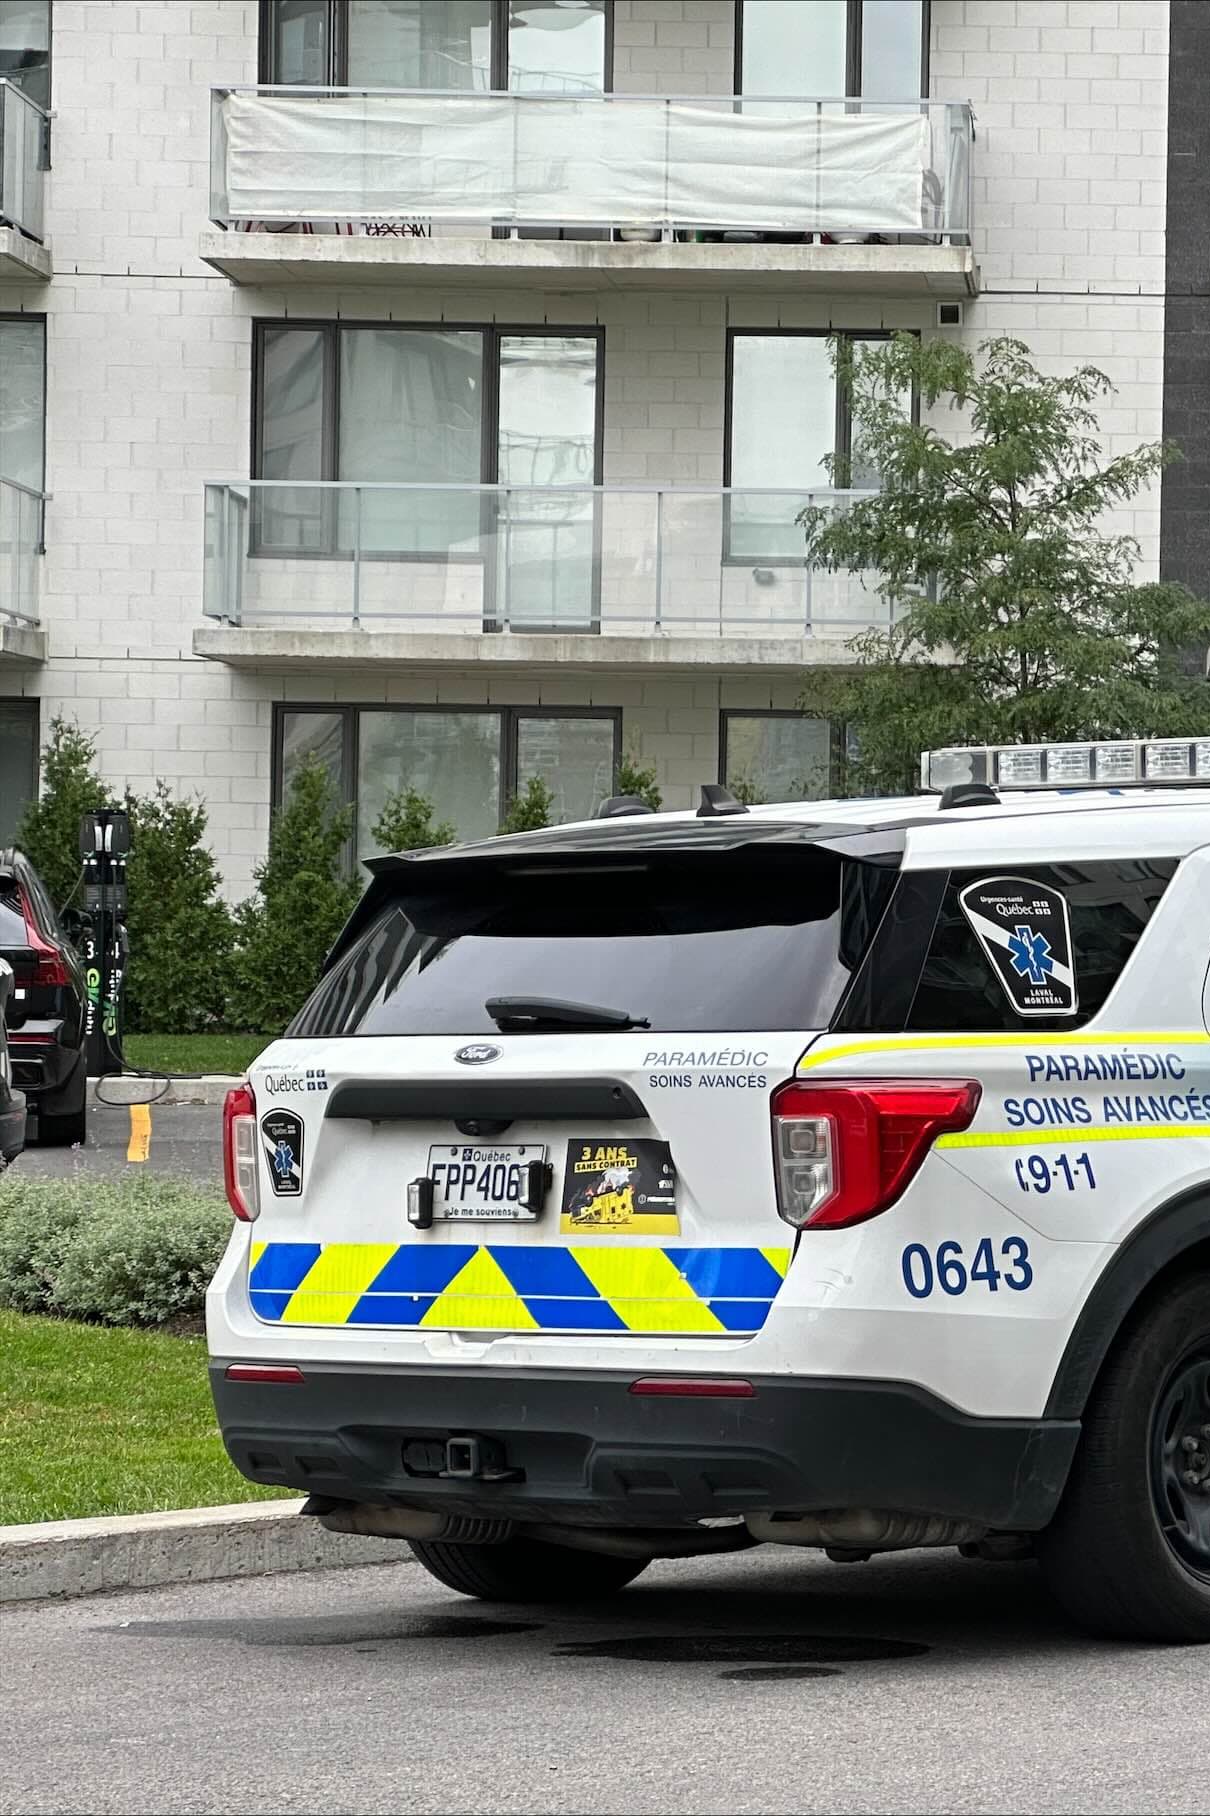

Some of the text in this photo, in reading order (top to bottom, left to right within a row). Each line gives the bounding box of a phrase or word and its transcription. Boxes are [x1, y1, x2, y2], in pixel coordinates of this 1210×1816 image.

[996, 903, 1034, 917] Québec
[461, 1046, 491, 1059] Ford
[642, 1048, 769, 1066] PARAMÉDIC
[1025, 1048, 1186, 1082] PARAMÉDIC
[265, 1074, 305, 1095] Québec
[649, 1072, 767, 1088] SOINS AVANCÉS
[1003, 1095, 1092, 1126] SOINS
[473, 1150, 511, 1161] Québec
[581, 1146, 627, 1161] 3 ANS
[576, 1159, 636, 1171] SANS CONTRAT
[449, 1207, 512, 1216] Je me souviens
[901, 1236, 1033, 1299] 0643
